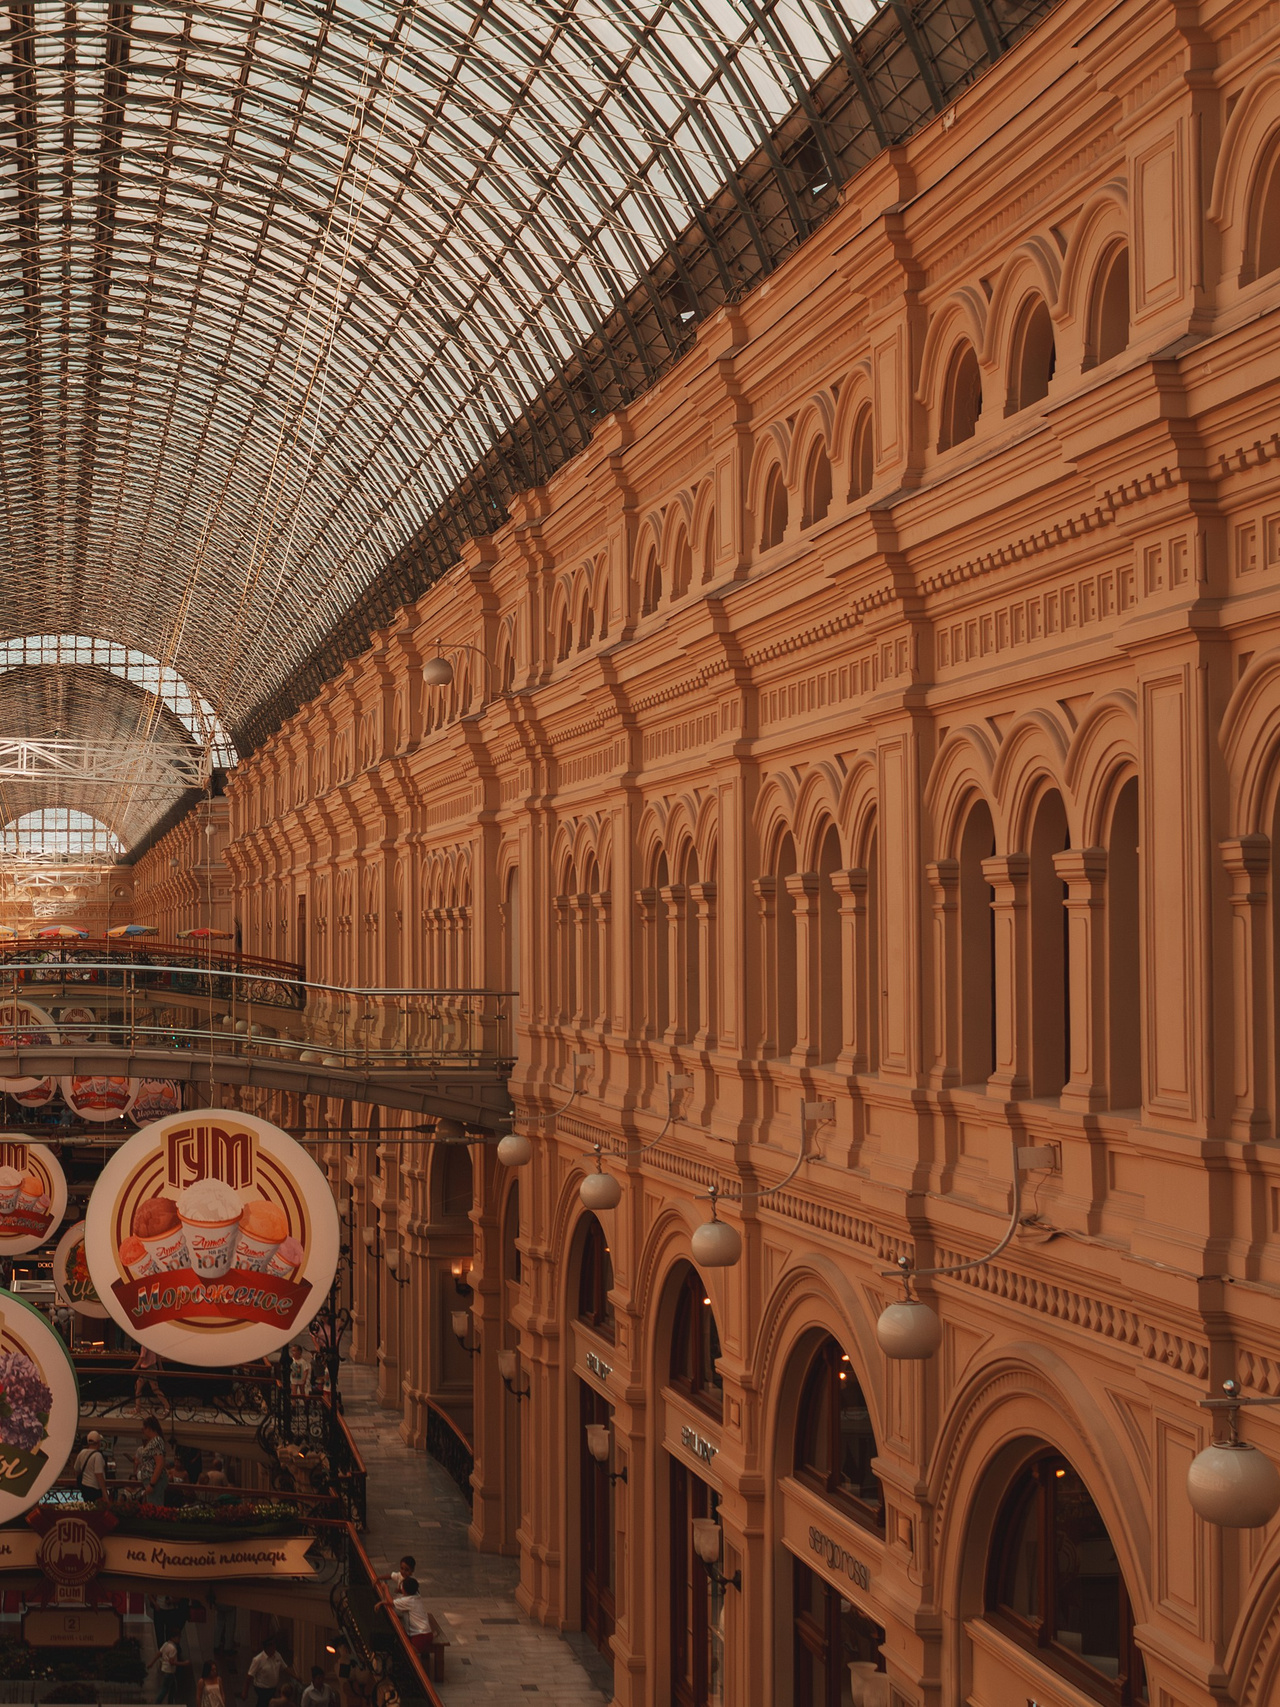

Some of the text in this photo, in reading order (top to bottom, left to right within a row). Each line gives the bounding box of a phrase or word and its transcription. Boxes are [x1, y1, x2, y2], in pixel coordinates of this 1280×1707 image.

[168, 1127, 253, 1190] ГУМ
[131, 1282, 294, 1317] Мороженое
[57, 1522, 87, 1544] ГУМ
[126, 1547, 288, 1570] на Красной площади
[58, 1587, 81, 1599] GUM
[68, 1618, 76, 1630] 2
